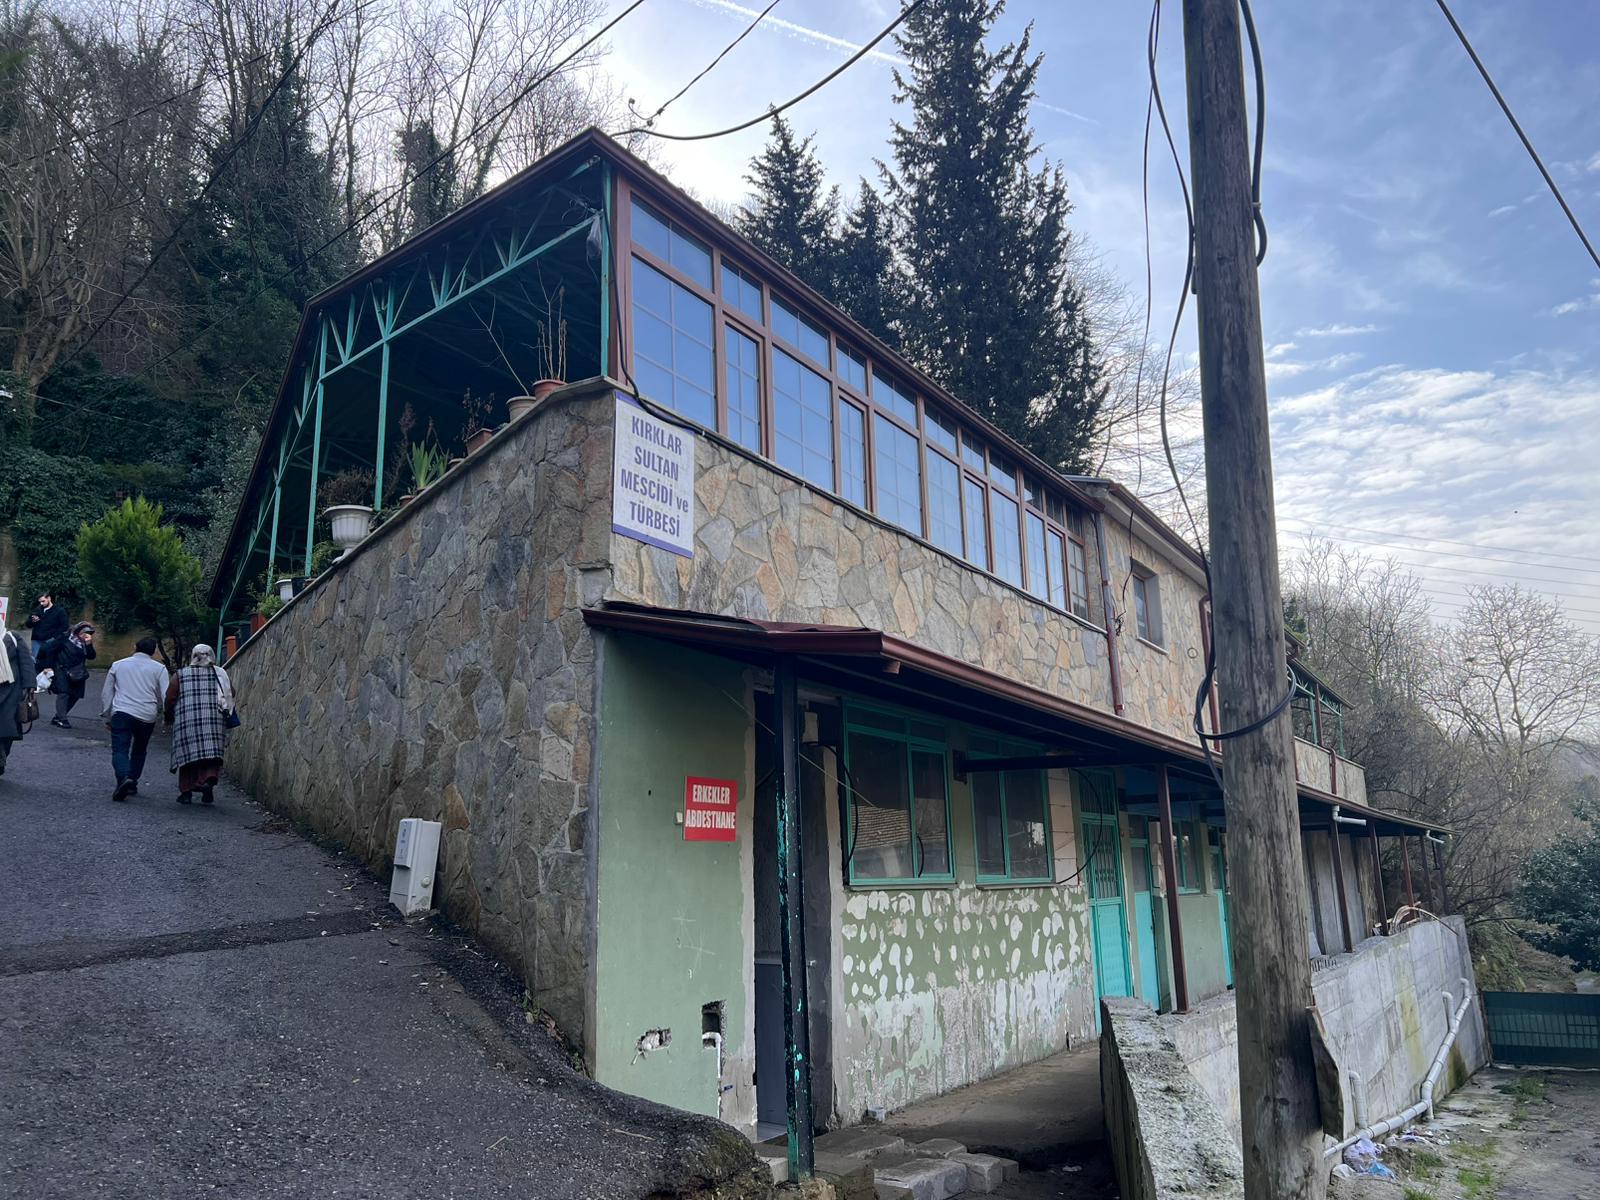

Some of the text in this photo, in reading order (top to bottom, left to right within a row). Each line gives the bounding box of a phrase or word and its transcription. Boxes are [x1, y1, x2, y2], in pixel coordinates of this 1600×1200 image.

[632, 415, 682, 455] KIRKLAR
[634, 446, 679, 481] SULTAN
[621, 468, 689, 513] MESCİDİ ve
[630, 501, 680, 537] TÜRBESİ
[692, 784, 730, 805] ERKEKLER
[685, 809, 736, 829] ABDESTHANE
